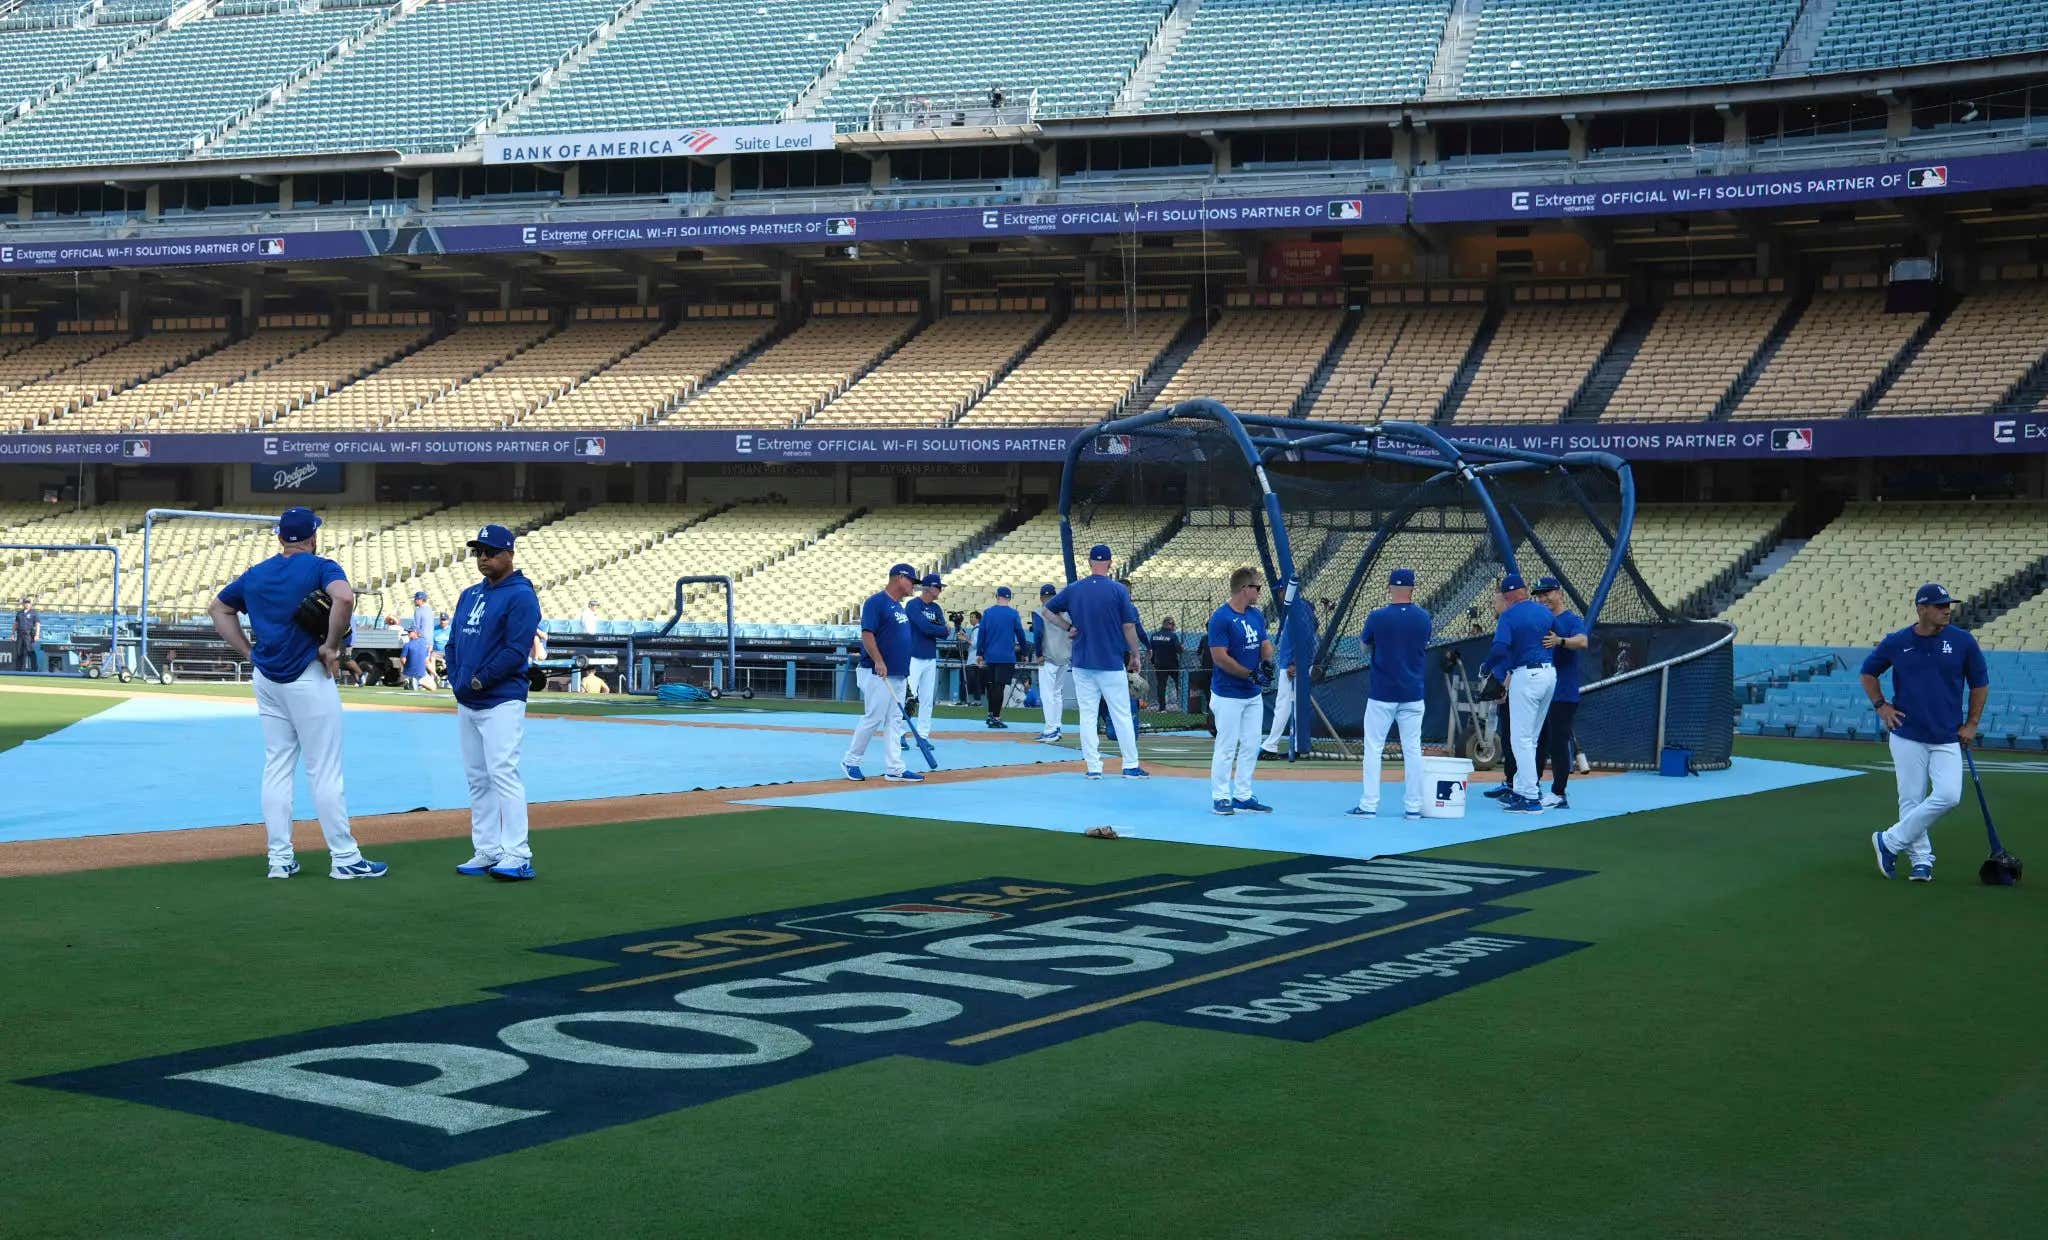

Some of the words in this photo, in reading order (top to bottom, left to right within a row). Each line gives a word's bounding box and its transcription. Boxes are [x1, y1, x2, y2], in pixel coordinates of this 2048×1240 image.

[502, 147, 552, 162] BANK
[558, 144, 581, 159] OF
[586, 140, 674, 158] AMERICA
[734, 136, 771, 151] Suite
[775, 133, 813, 149] Level
[1534, 194, 1593, 208] Extreme
[1601, 192, 1668, 206] OFFICIAL
[1672, 188, 1711, 201] WI-FI
[1715, 182, 1802, 200] SOLUTIONS
[1807, 177, 1875, 193] PARTNER
[1880, 174, 1902, 188] OF
[1003, 212, 1055, 226] Extreme
[1061, 210, 1120, 224] OFFICIAL
[1124, 208, 1158, 221] WI-FI
[1162, 206, 1238, 221] SOLUTIONS
[1241, 205, 1301, 219] PARTNER
[1304, 205, 1324, 217] OF
[541, 229, 588, 241] Extreme
[592, 228, 643, 241] OFFICIAL
[646, 227, 677, 239] WI-FI
[680, 225, 747, 237] SOLUTIONS
[750, 223, 803, 236] PARTNER
[805, 222, 822, 234] OF
[16, 249, 57, 260] Extreme
[60, 247, 104, 260] OFFICIAL
[107, 246, 133, 258] WI-FI
[135, 245, 192, 257] SOLUTIONS
[194, 243, 239, 255] PARTNER
[241, 242, 256, 253] OF
[2023, 423, 2048, 439] Ex
[55, 443, 101, 455] PARTNER
[103, 443, 120, 454] OF
[282, 440, 331, 453] Extreme
[334, 440, 387, 453] OFFICIAL
[390, 440, 422, 453] WI-FI
[425, 440, 494, 453] SOLUTIONS
[496, 440, 550, 453] PARTNER
[553, 440, 571, 453] OF
[757, 438, 813, 451] Extreme
[817, 438, 878, 452] OFFICIAL
[882, 438, 918, 452] WI-FI
[921, 438, 1001, 452] SOLUTIONS
[1004, 438, 1067, 452] PARTNER
[1522, 437, 1564, 450] WI-FI
[1568, 436, 1661, 450] SOLUTIONS
[1665, 435, 1737, 449] PARTNER
[1742, 433, 1766, 447] OF
[273, 461, 318, 490] Dodgers
[1240, 620, 1258, 643] LA
[1942, 640, 1953, 654] LA
[1186, 936, 1528, 1025] Booking.com
[164, 857, 1545, 1136] POSTSEASON
